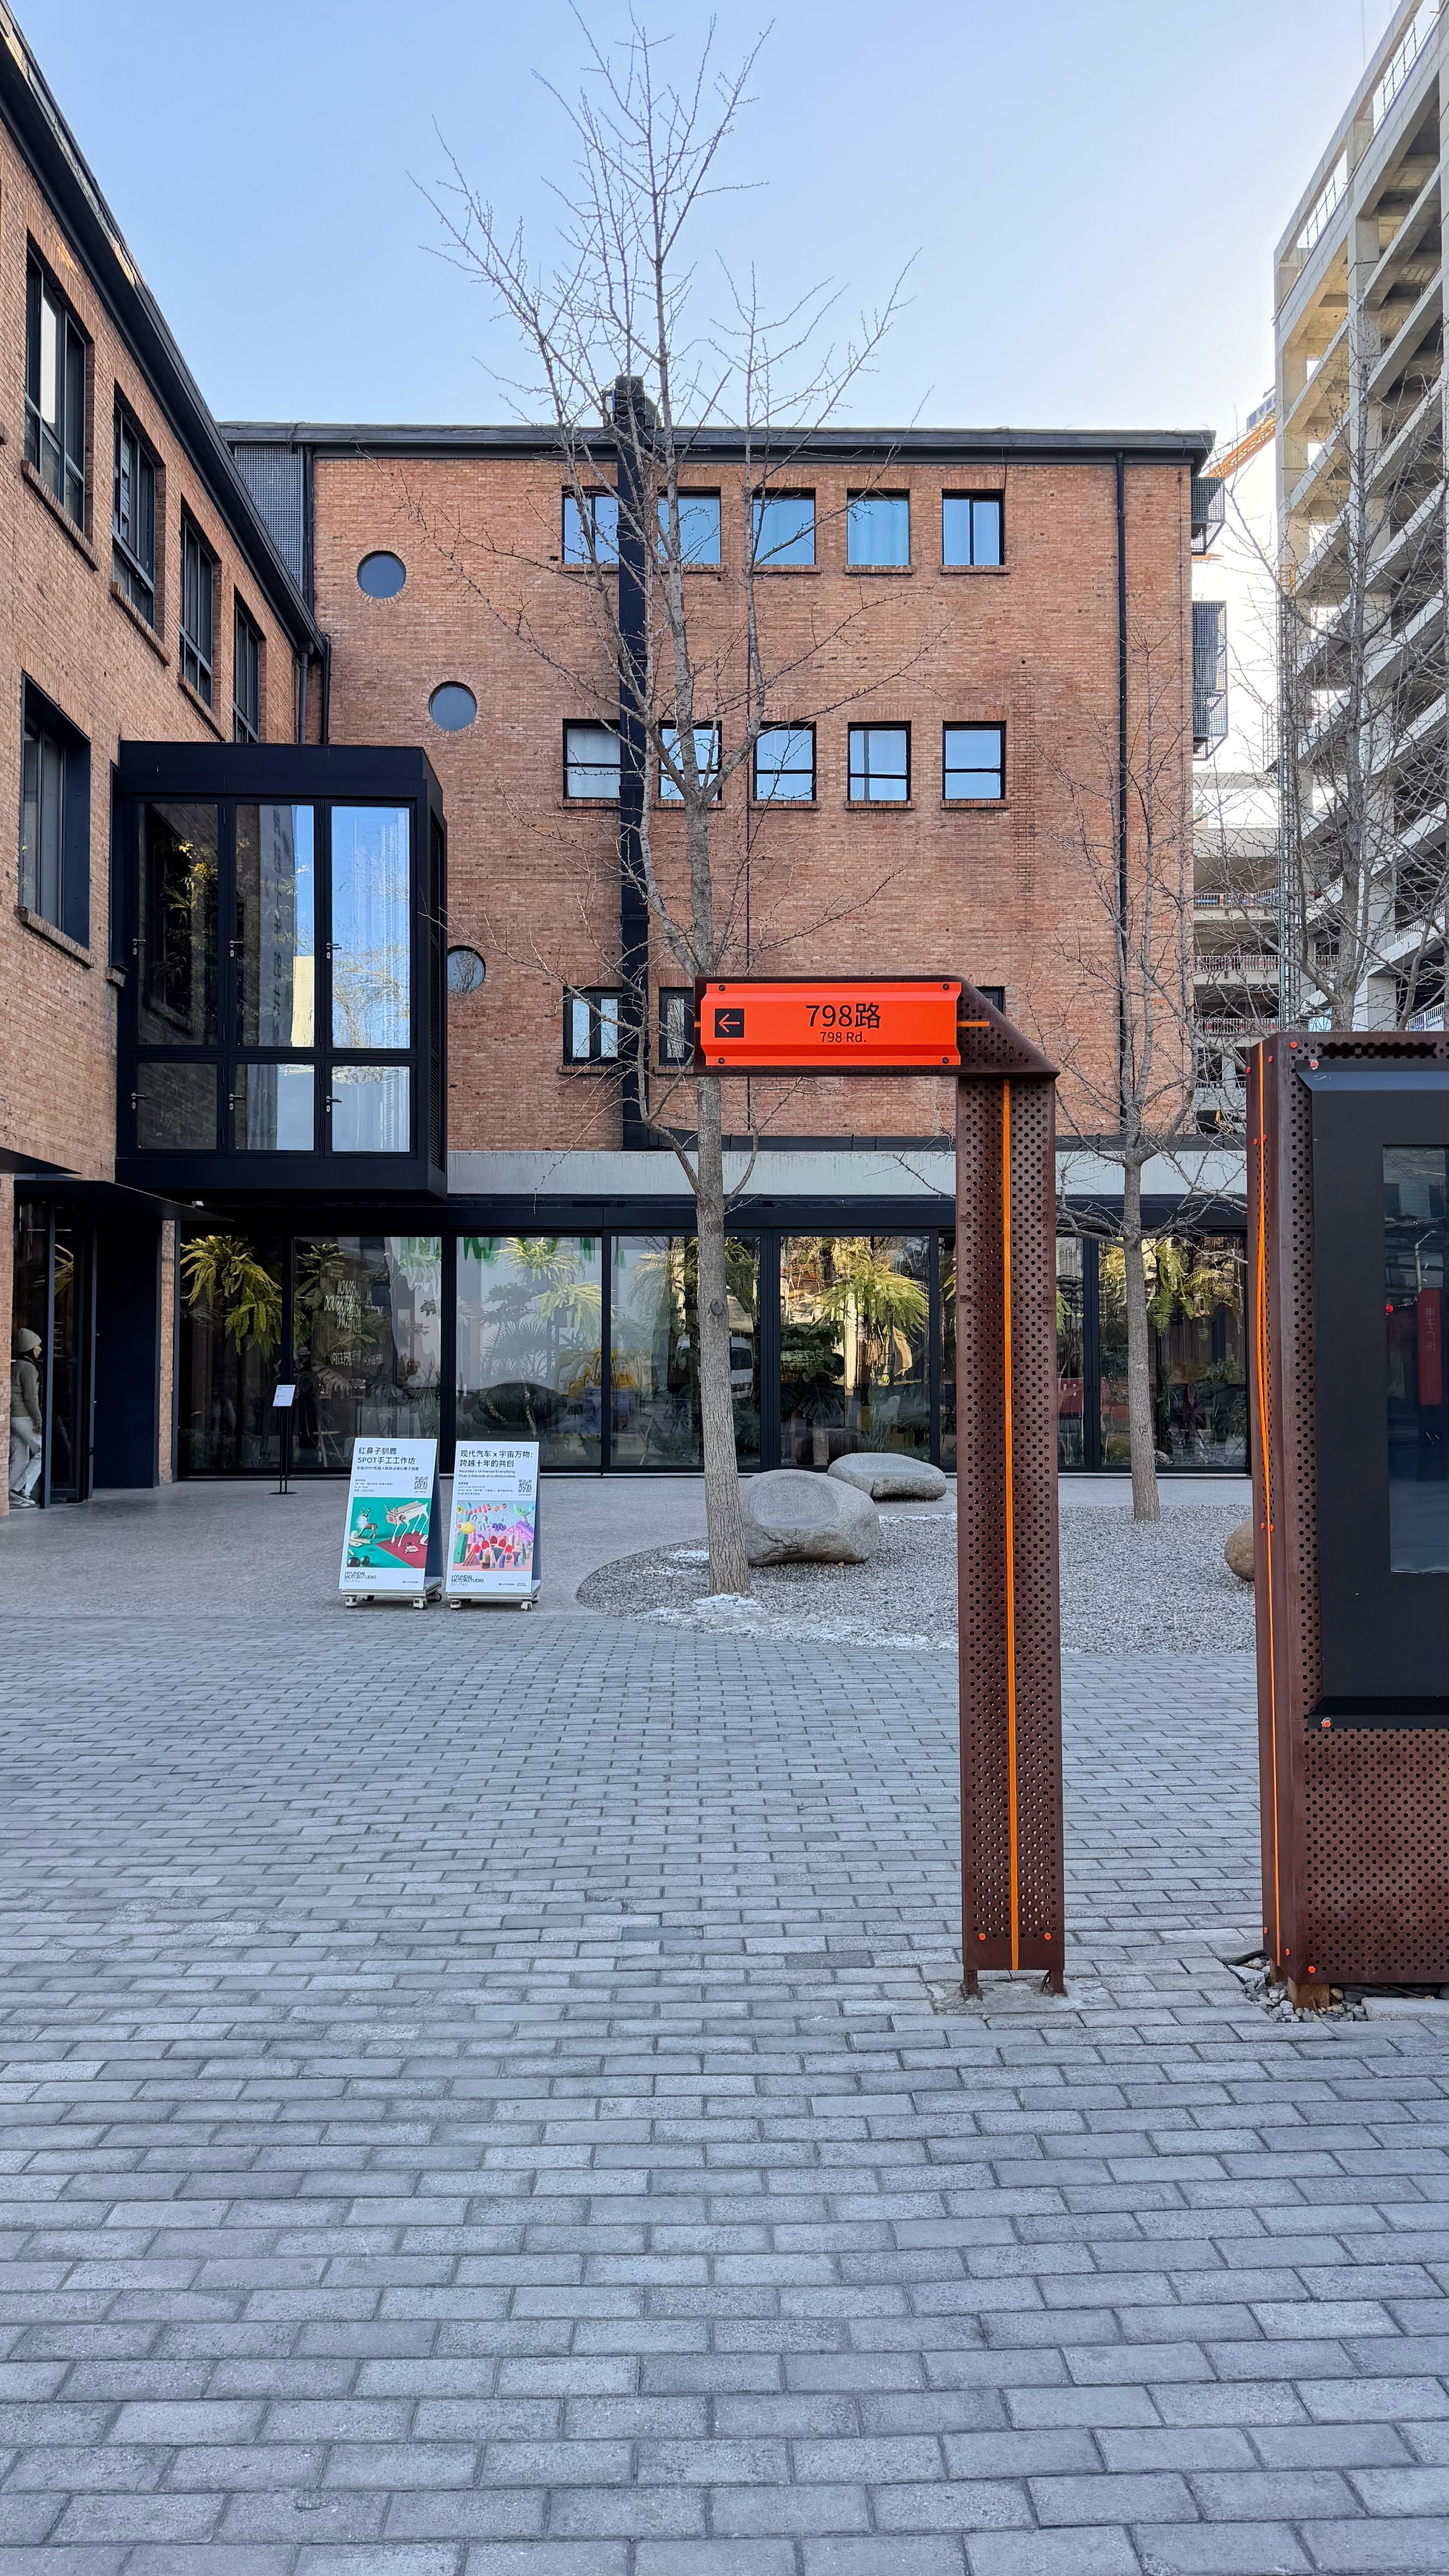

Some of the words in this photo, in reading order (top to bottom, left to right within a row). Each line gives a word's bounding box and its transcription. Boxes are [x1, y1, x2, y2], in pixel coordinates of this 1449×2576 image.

[805, 1003, 882, 1029] 798路
[819, 1031, 842, 1043] 798
[846, 1031, 867, 1043] Rd.
[358, 1447, 397, 1455] 红鼻子驯鹿
[357, 1457, 415, 1465] SPOT手工工作坊
[460, 1459, 514, 1467] 跨越十年的共创
